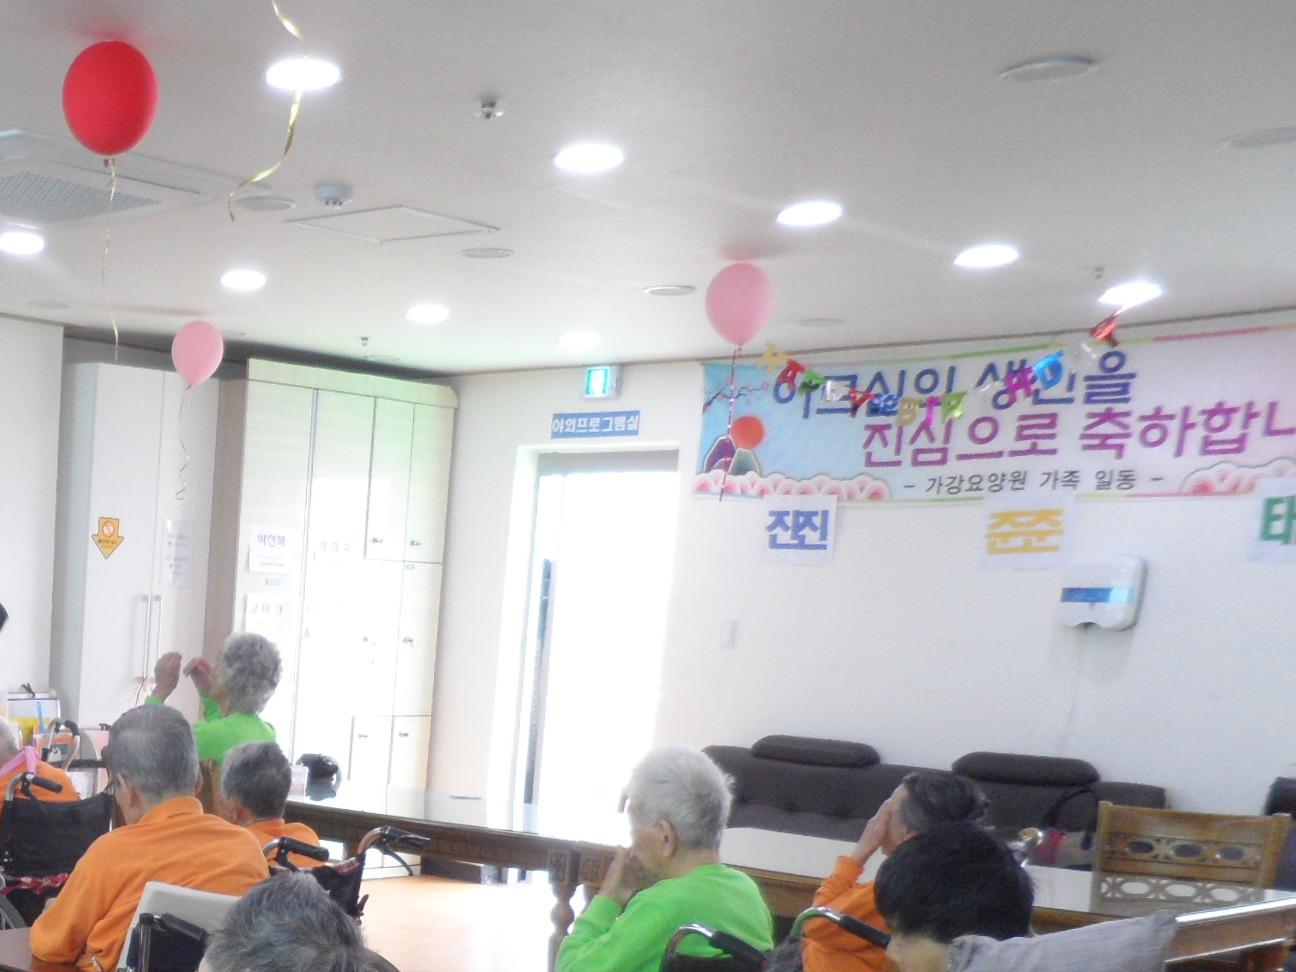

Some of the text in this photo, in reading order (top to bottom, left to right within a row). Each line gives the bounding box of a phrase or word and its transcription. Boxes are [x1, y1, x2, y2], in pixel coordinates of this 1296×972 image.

[863, 412, 1058, 468] 진심으로
[926, 470, 1028, 495] 가강요양원
[1039, 470, 1081, 490] 가족
[1095, 469, 1136, 491] 일동
